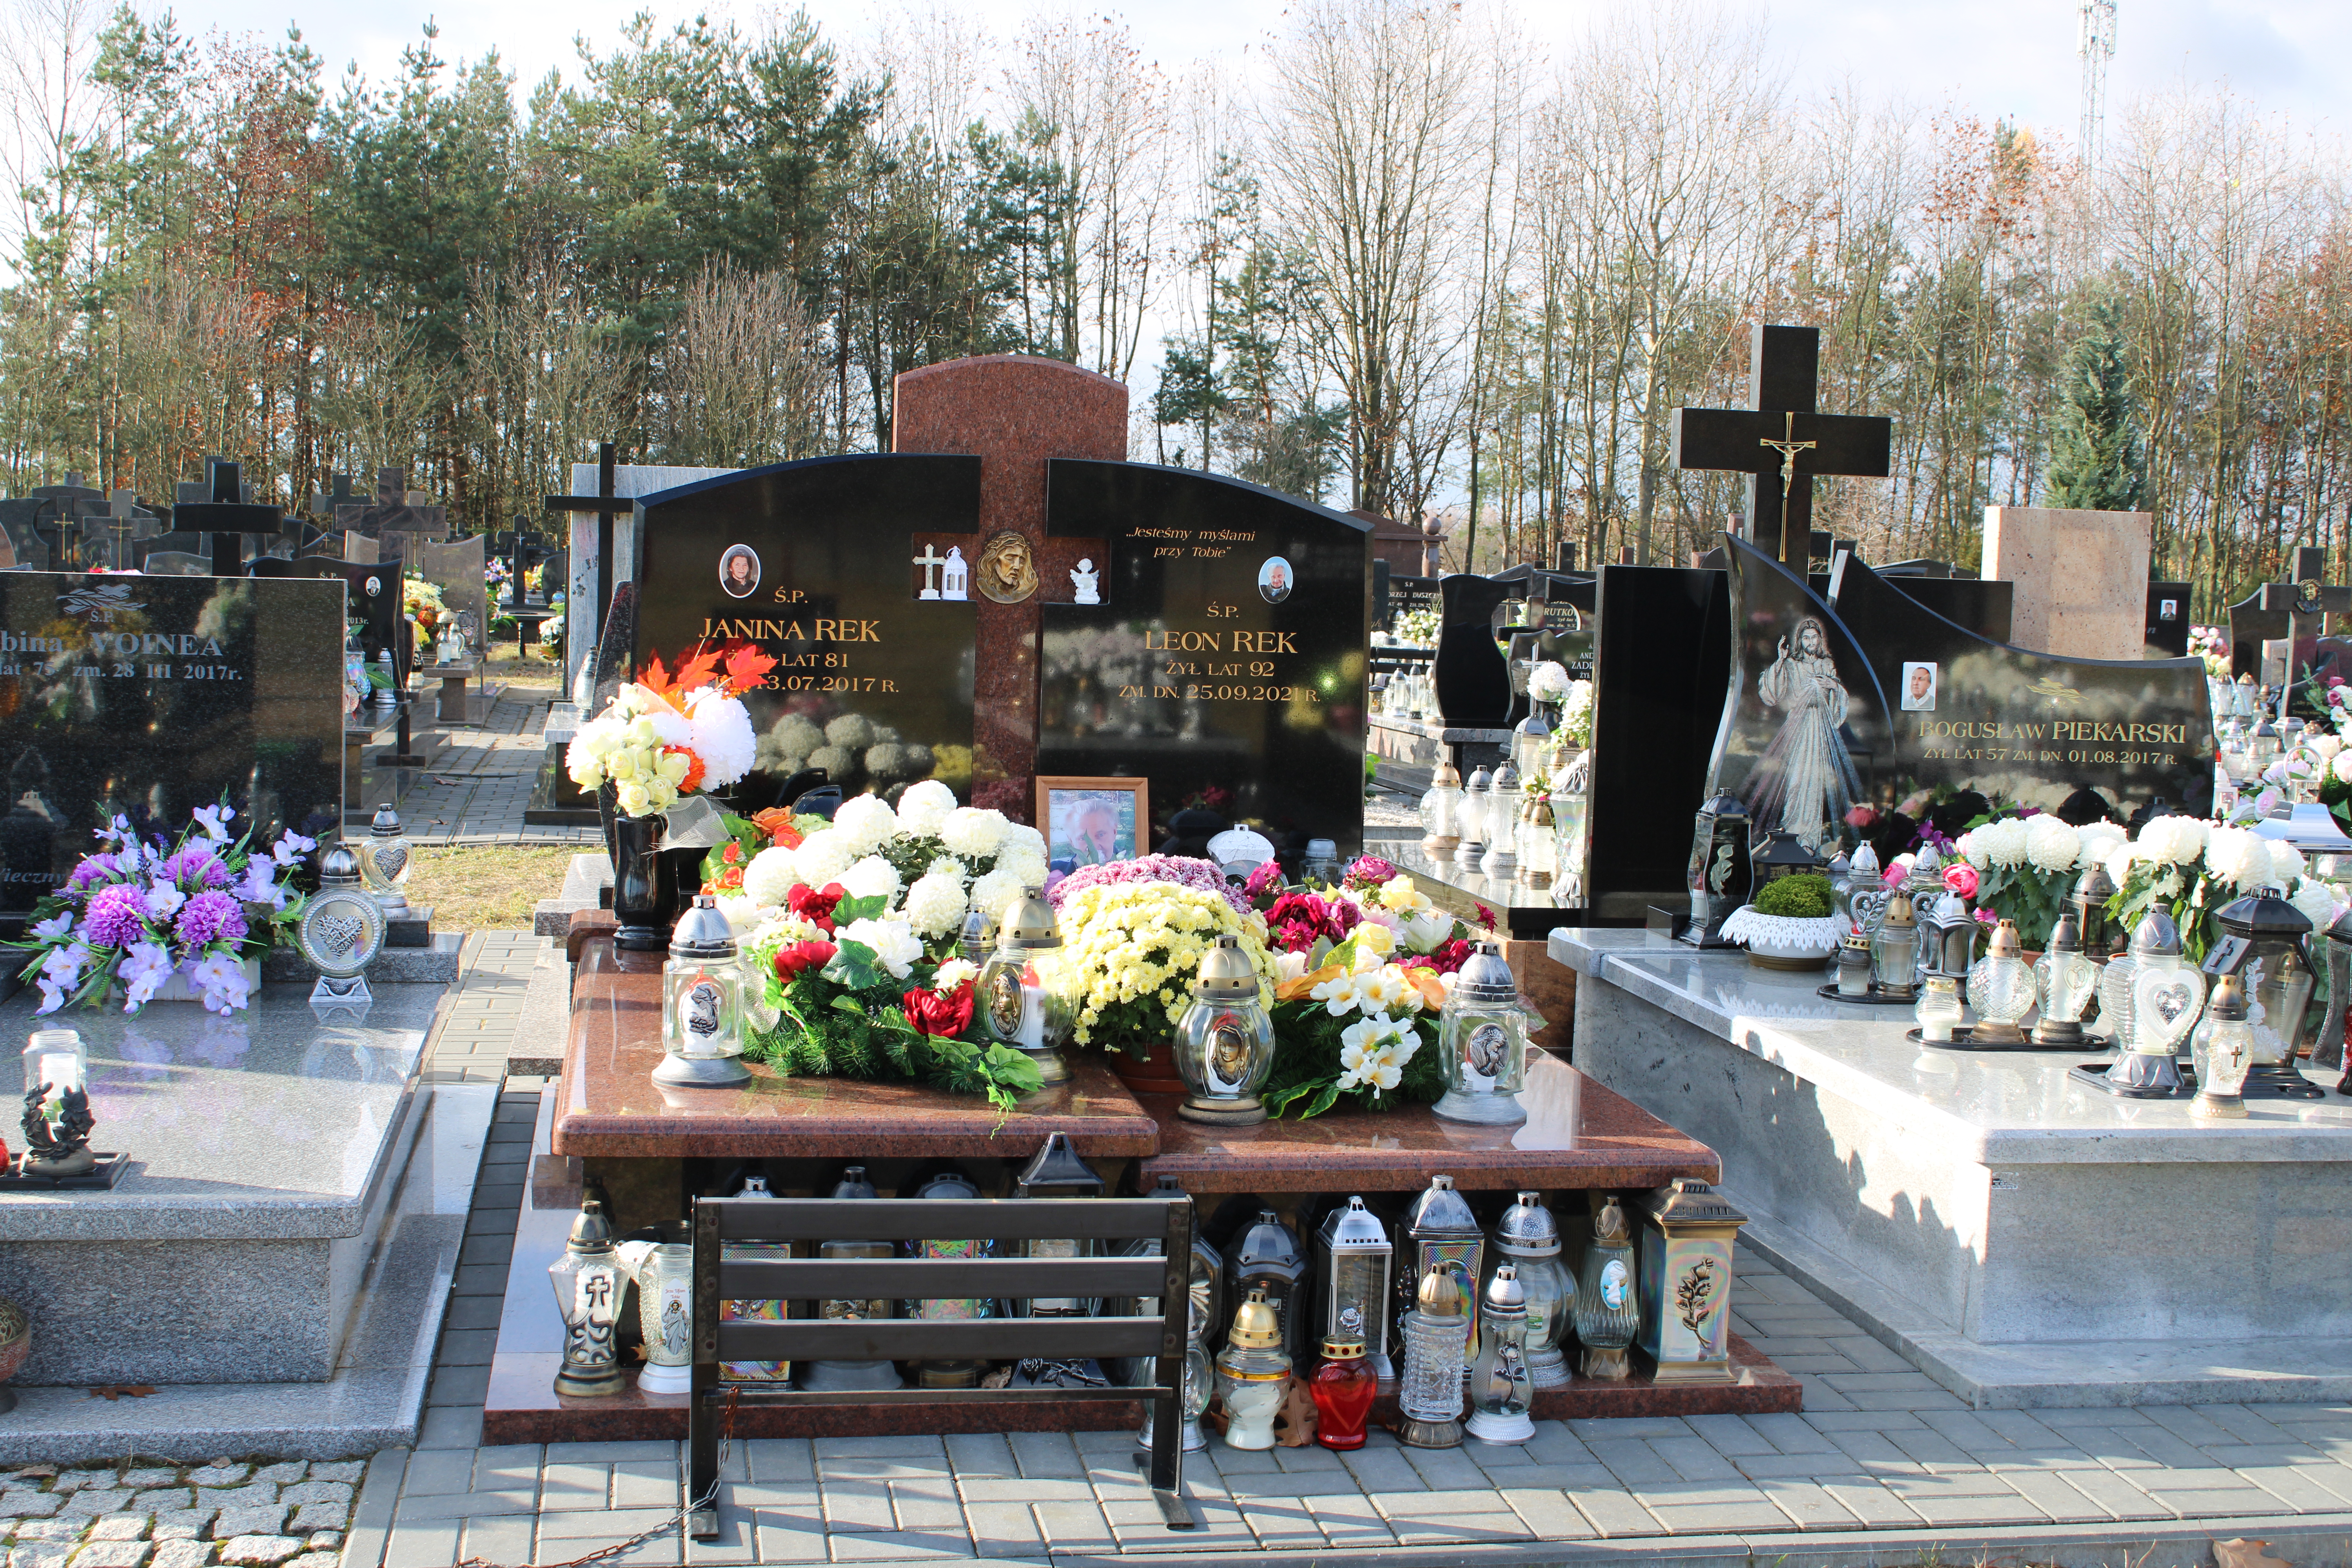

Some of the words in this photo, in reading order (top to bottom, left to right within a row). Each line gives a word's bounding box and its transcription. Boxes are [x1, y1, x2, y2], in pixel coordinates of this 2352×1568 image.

[1199, 529, 1256, 542] myślami
[1154, 547, 1185, 558] przy
[775, 586, 808, 603] Ś.P.
[91, 608, 114, 622] Ś.P.
[1207, 601, 1239, 618] Ś.P.
[699, 618, 806, 641] JANINA
[815, 619, 880, 642] REK
[90, 632, 223, 656] VOINEA
[1145, 631, 1220, 652] LEON
[1232, 631, 1298, 653] REK
[782, 654, 819, 667] LAT
[825, 653, 848, 668] 81
[1166, 659, 1201, 675] ŻYŁ
[1208, 663, 1242, 676] LAT
[1250, 662, 1274, 677] 92
[34, 661, 56, 676] 75
[72, 666, 106, 677] zm.
[113, 663, 134, 677] 28
[147, 664, 171, 678] III
[184, 664, 242, 680] 2017r.
[882, 680, 899, 692] R.
[1119, 686, 1146, 698] ZM.
[1154, 686, 1180, 699] DN.
[1187, 685, 1299, 701] 25.09.2021
[1305, 689, 1320, 702] R.
[1919, 721, 2046, 739] BOGUSŁAW
[2052, 721, 2186, 743] PIEKARSKI
[1954, 749, 1983, 759] LAT
[1986, 748, 2008, 760] 57
[2013, 750, 2035, 761] ZM.
[2040, 751, 2064, 762] DN.
[2068, 750, 2161, 764] 01.08.2017
[2165, 754, 2178, 764] R.
